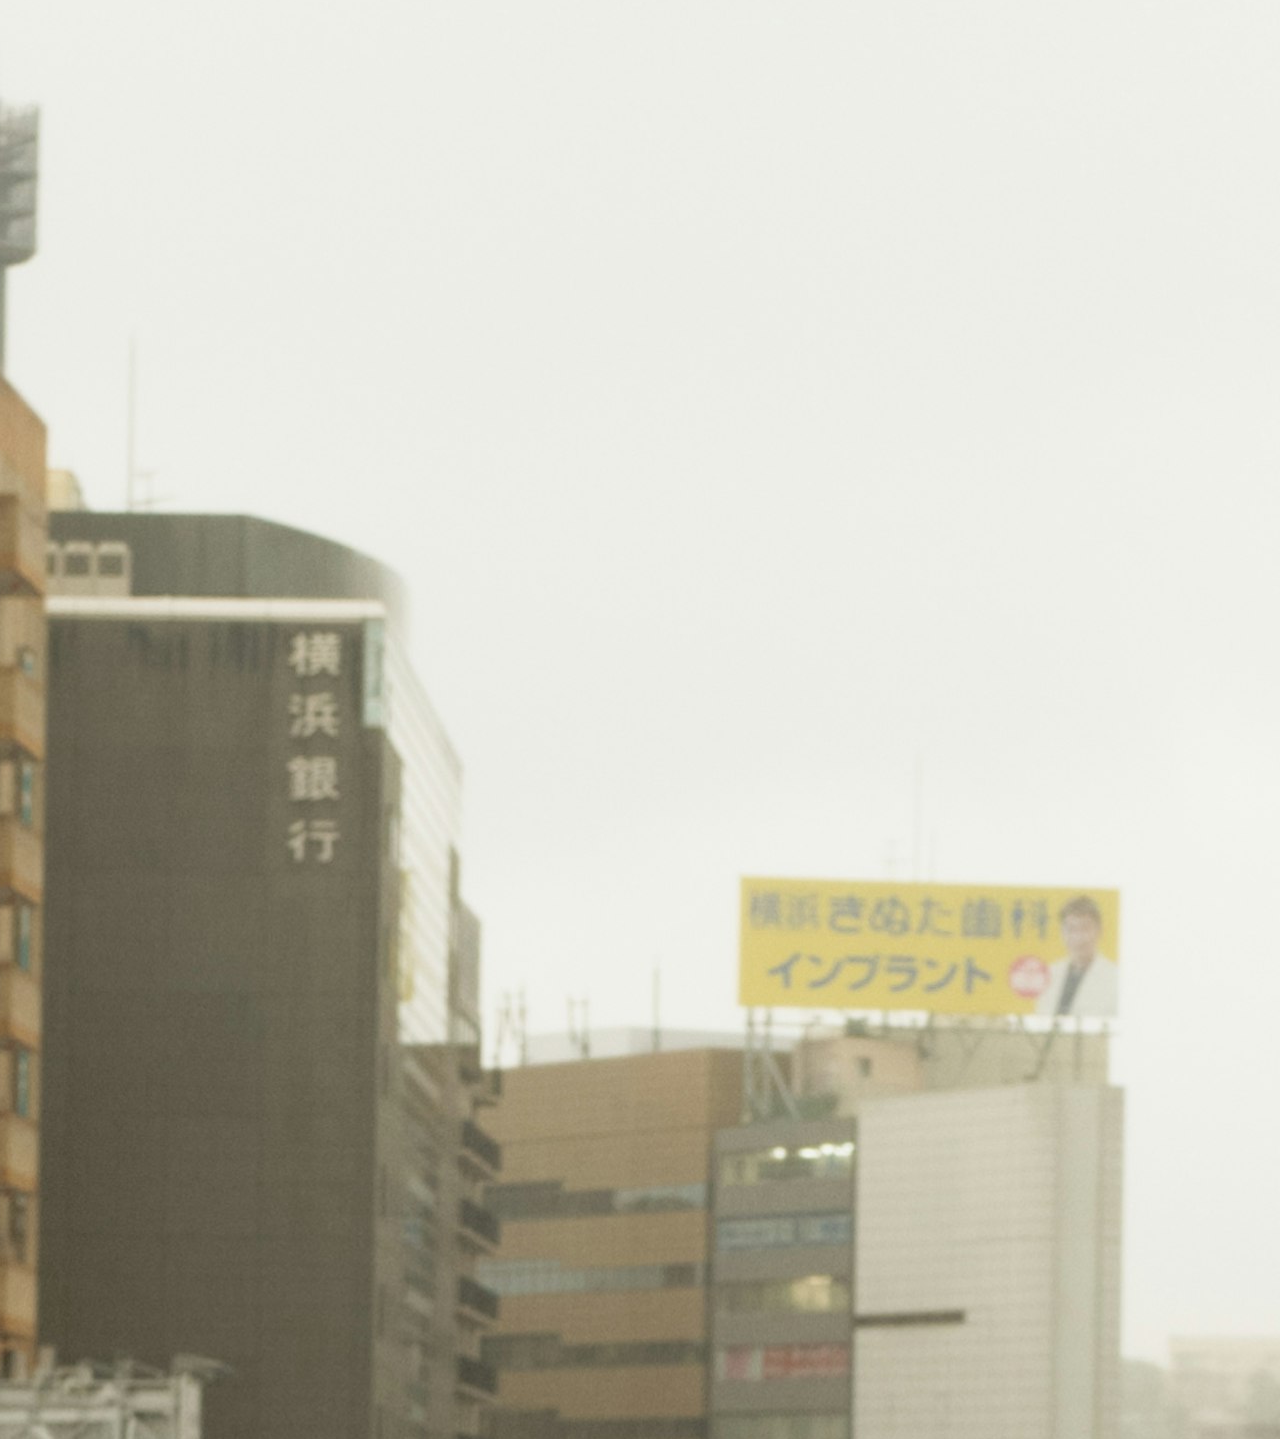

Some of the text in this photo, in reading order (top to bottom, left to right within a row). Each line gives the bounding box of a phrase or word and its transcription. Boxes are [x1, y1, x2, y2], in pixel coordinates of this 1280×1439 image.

[287, 633, 344, 865] 横浜銀行
[748, 890, 1050, 940] 横浜きぬた歯科
[767, 952, 993, 996] インプラント
